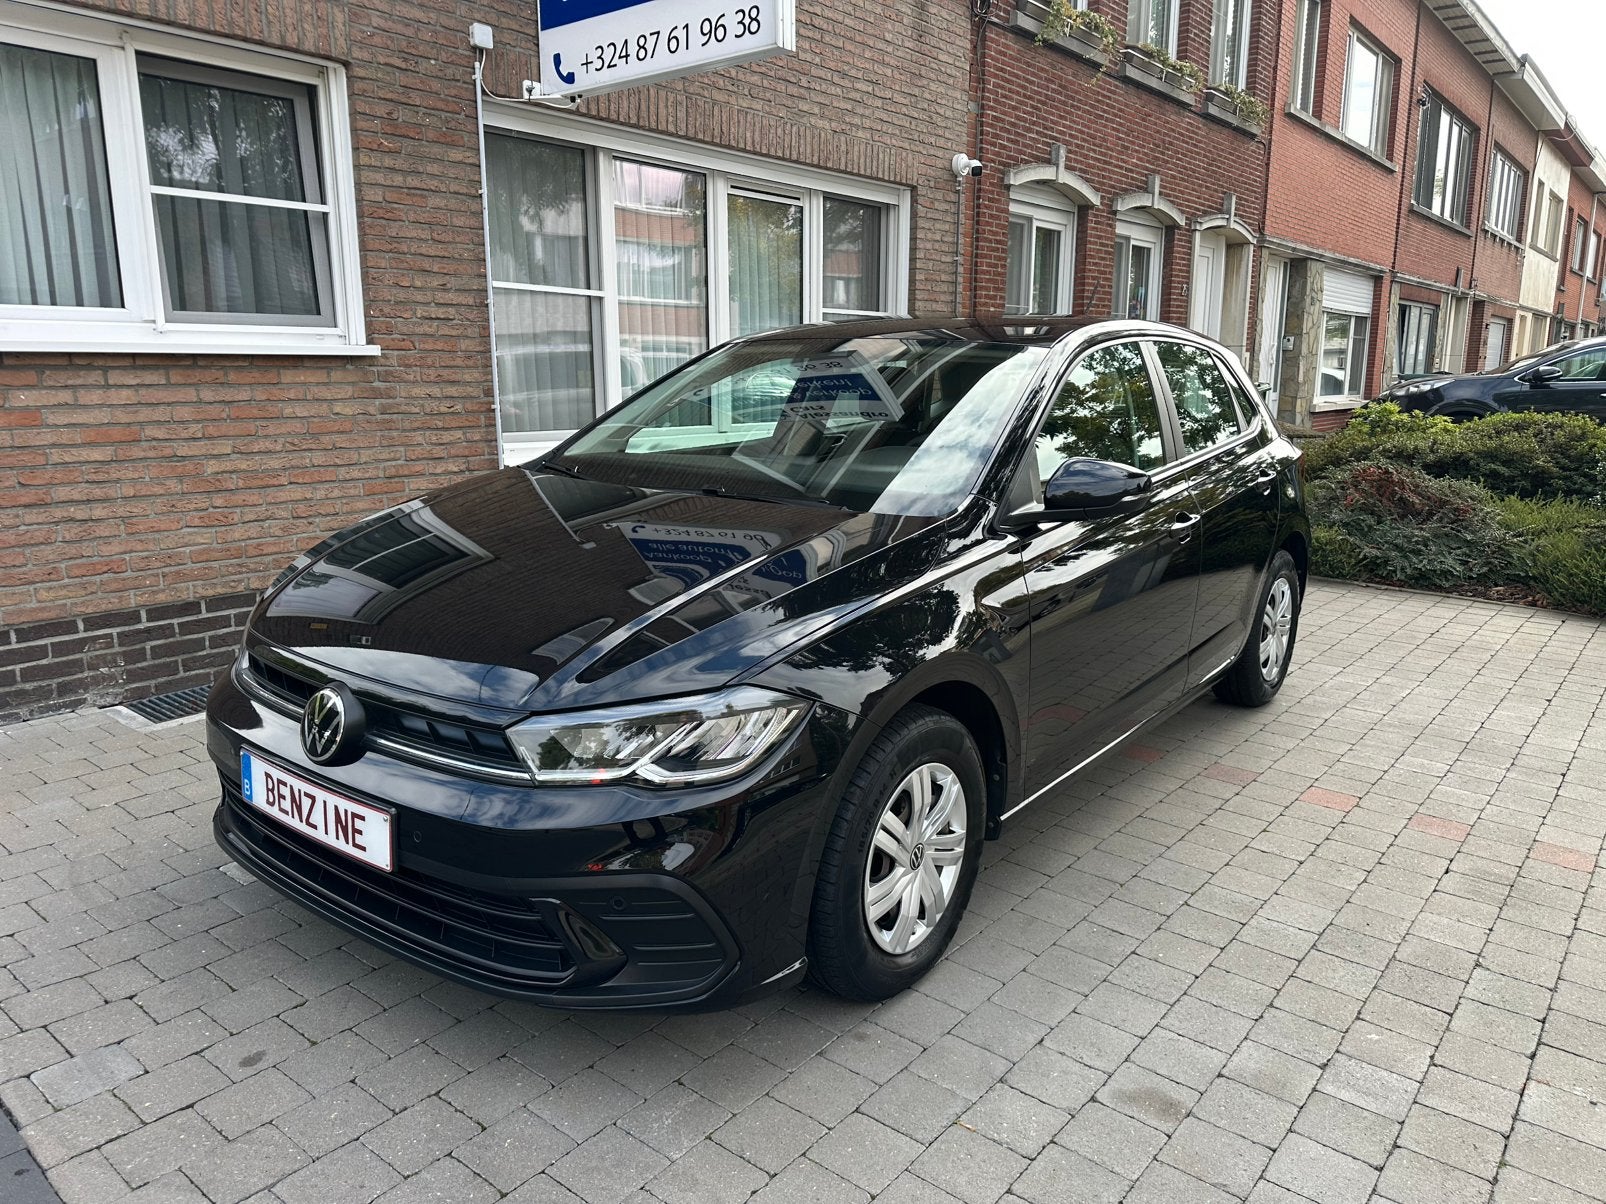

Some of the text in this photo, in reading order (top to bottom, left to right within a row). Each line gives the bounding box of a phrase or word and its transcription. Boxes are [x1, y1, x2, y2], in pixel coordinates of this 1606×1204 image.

[580, 5, 761, 74] +324 87 61 96 38
[244, 778, 251, 795] B
[264, 771, 367, 853] BENZINE
